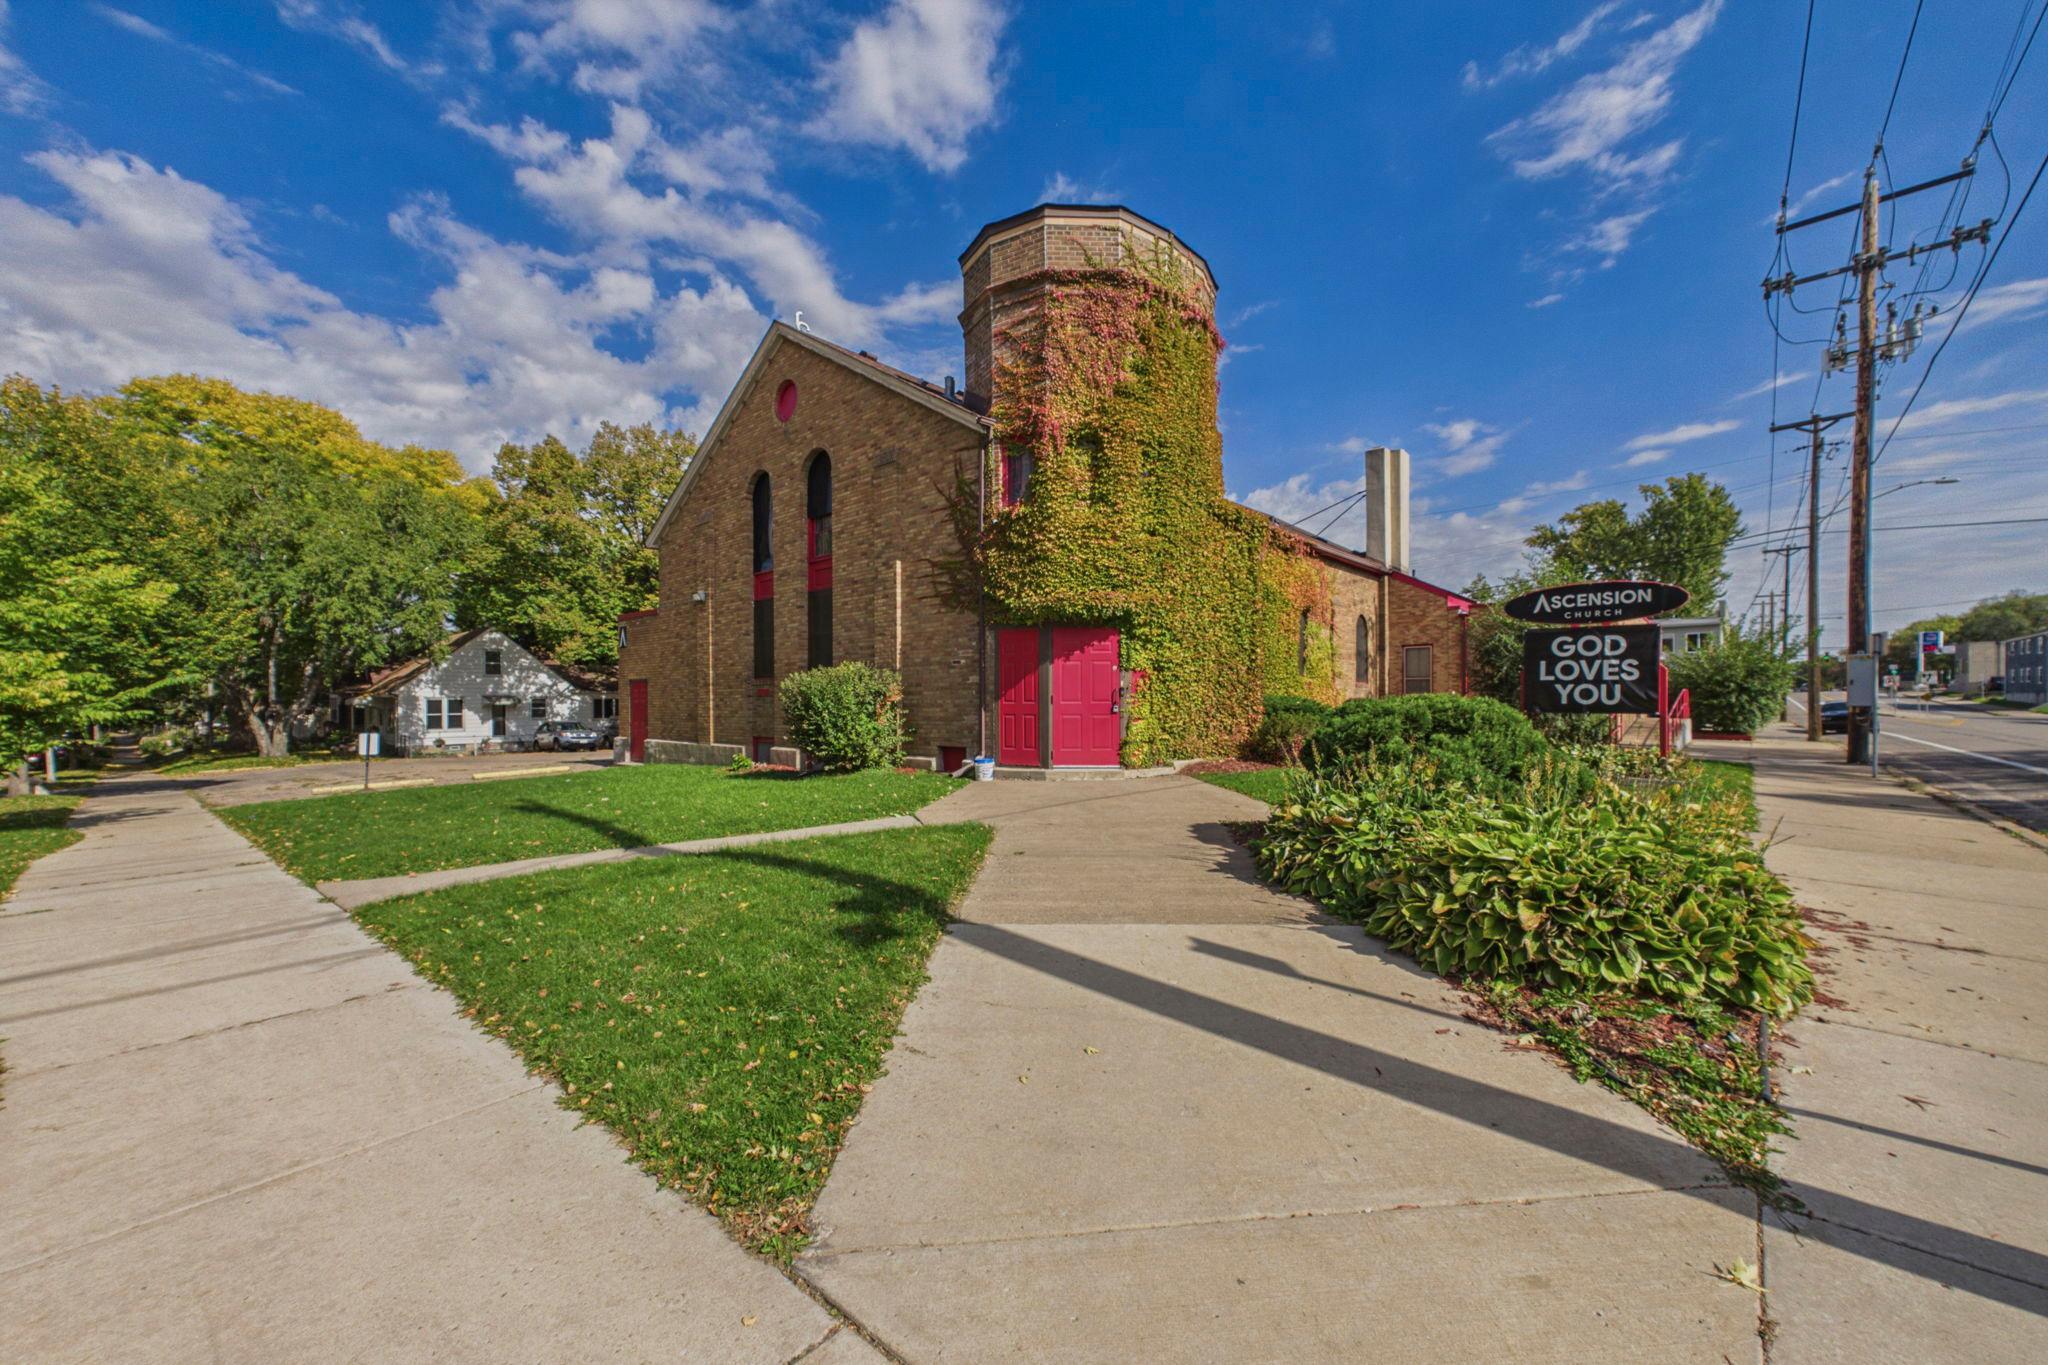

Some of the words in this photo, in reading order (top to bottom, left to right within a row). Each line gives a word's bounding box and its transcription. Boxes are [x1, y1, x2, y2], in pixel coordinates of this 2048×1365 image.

[1533, 588, 1652, 614] ASCENSION
[1564, 608, 1622, 620] CHURCH
[1551, 635, 1627, 657] GOD
[1539, 658, 1640, 682] LOVES
[1554, 683, 1621, 706] YOU
